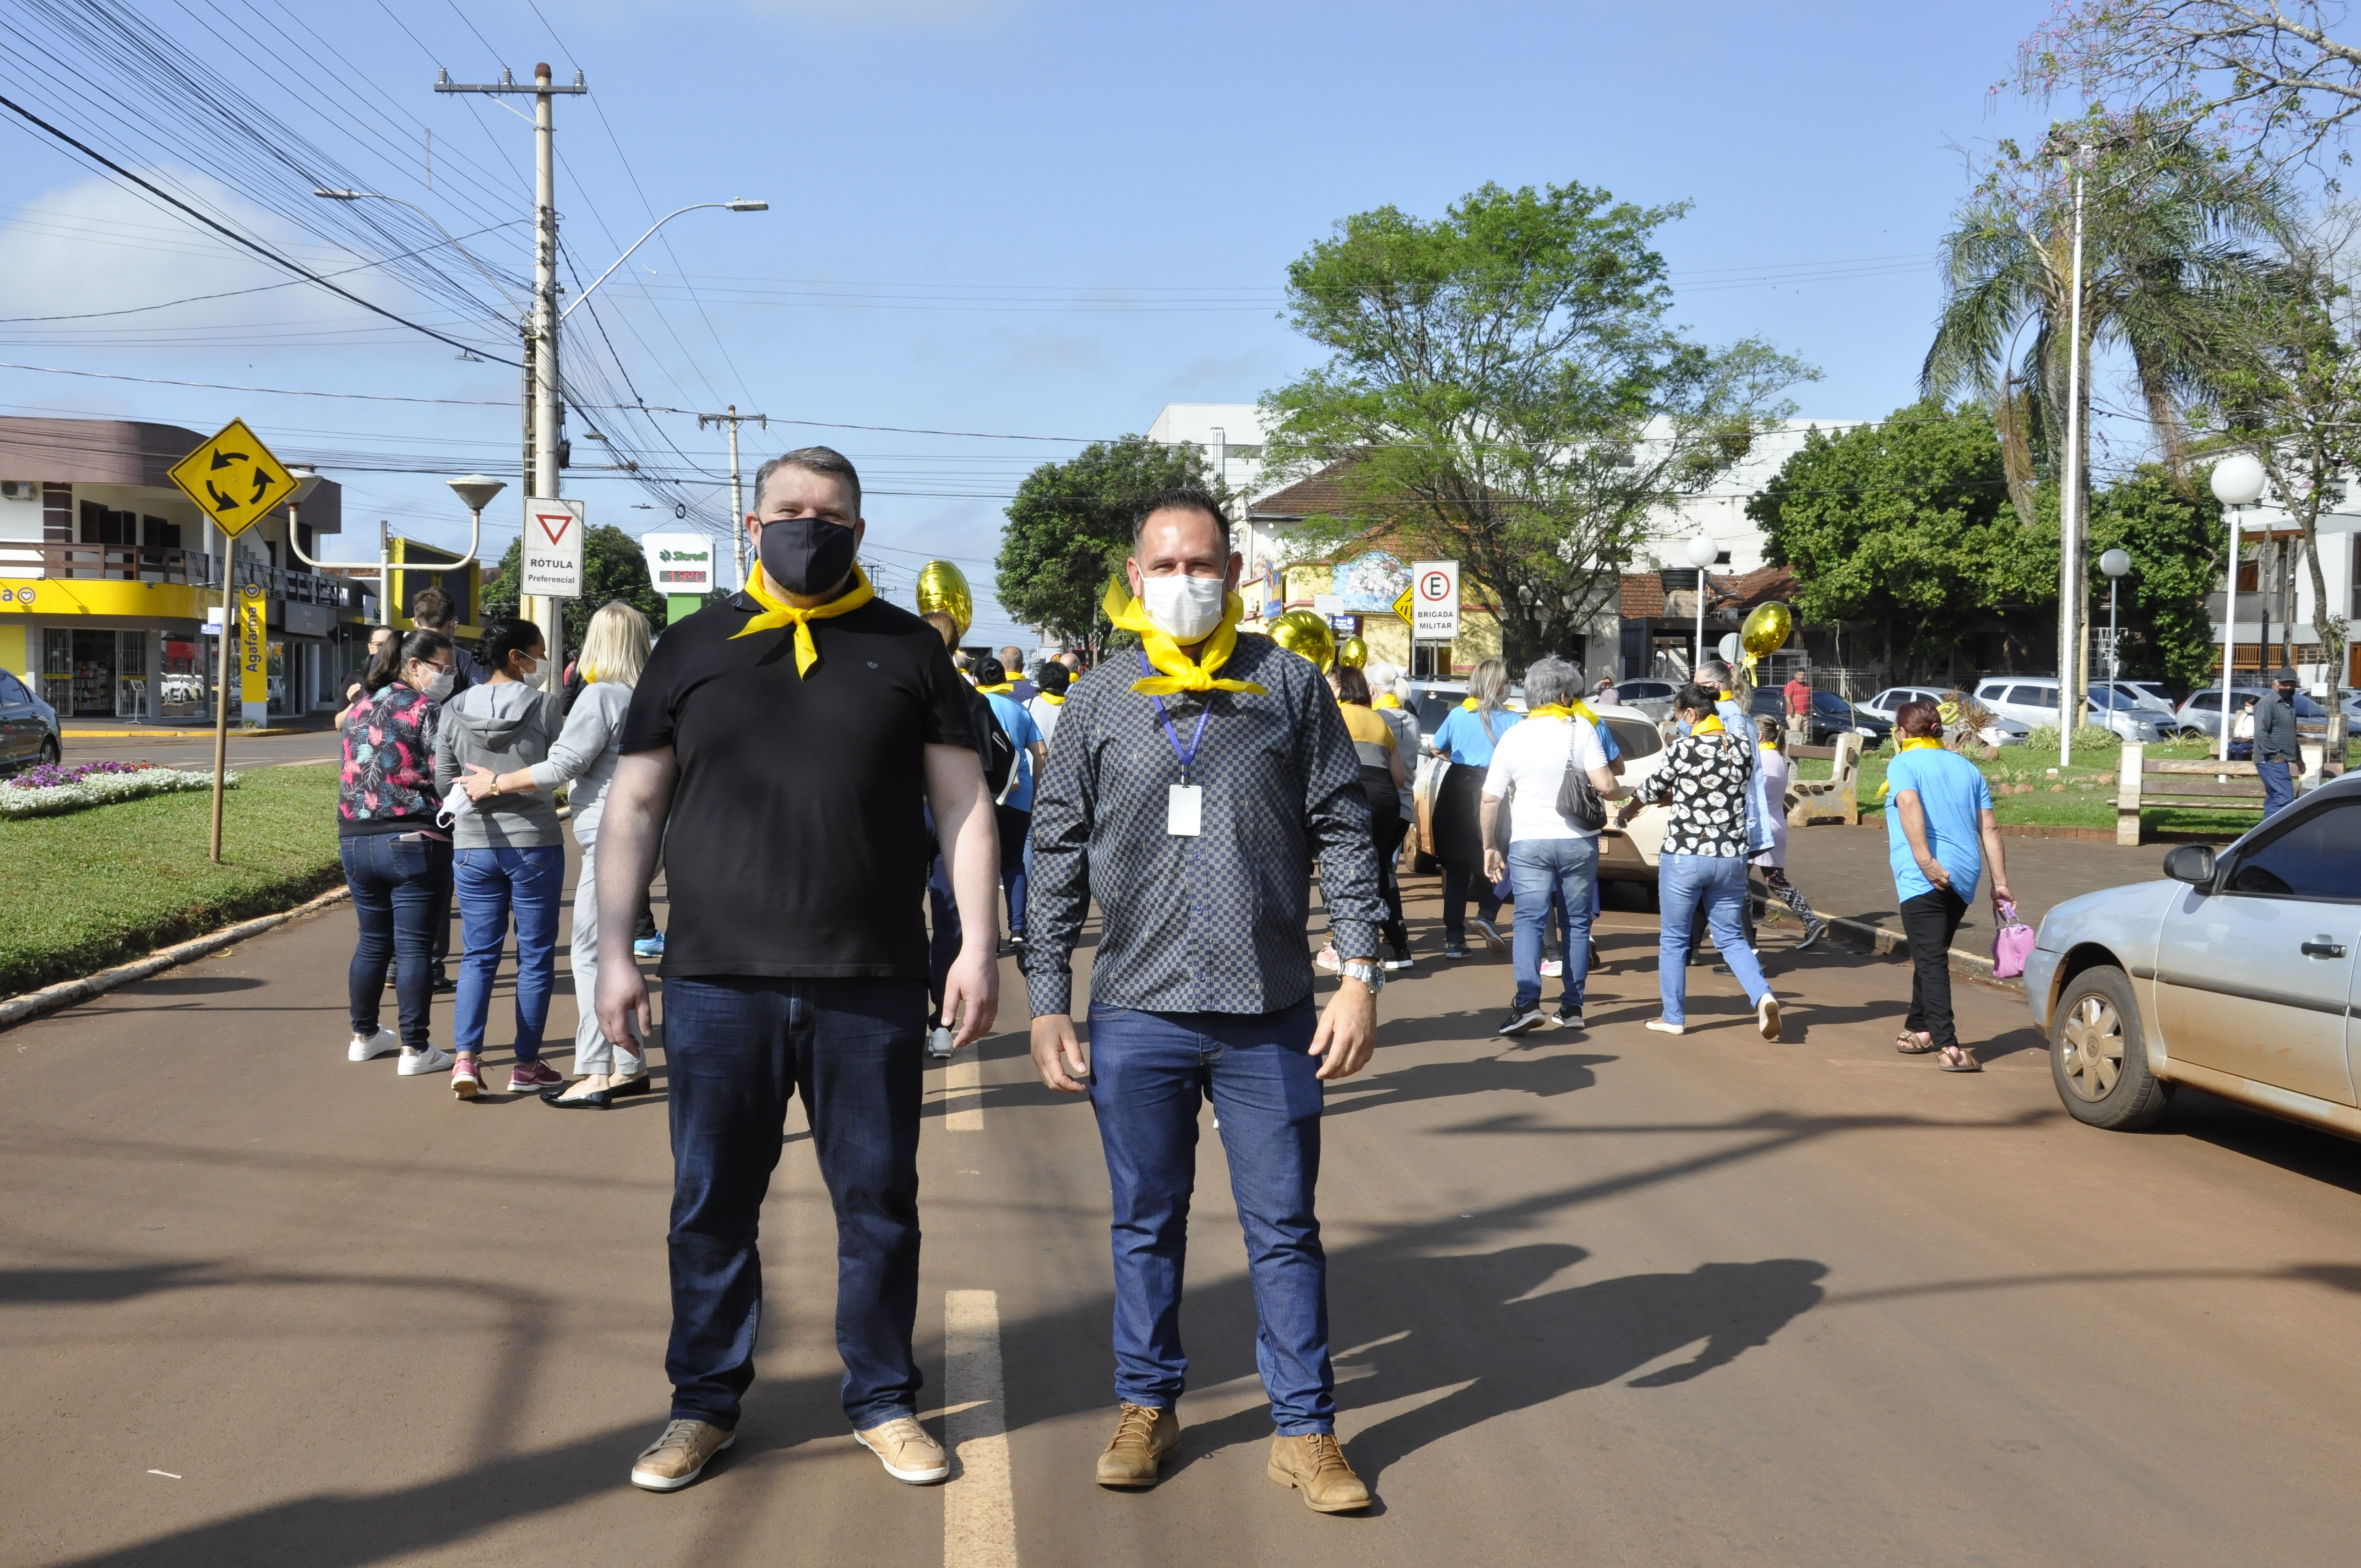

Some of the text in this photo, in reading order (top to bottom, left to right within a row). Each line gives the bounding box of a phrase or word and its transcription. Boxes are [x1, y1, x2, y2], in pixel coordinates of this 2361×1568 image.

[530, 557, 573, 569] RÓTULA
[528, 574, 575, 584] Preferencial
[1430, 577, 1441, 595] E
[244, 607, 262, 673] Agafarma
